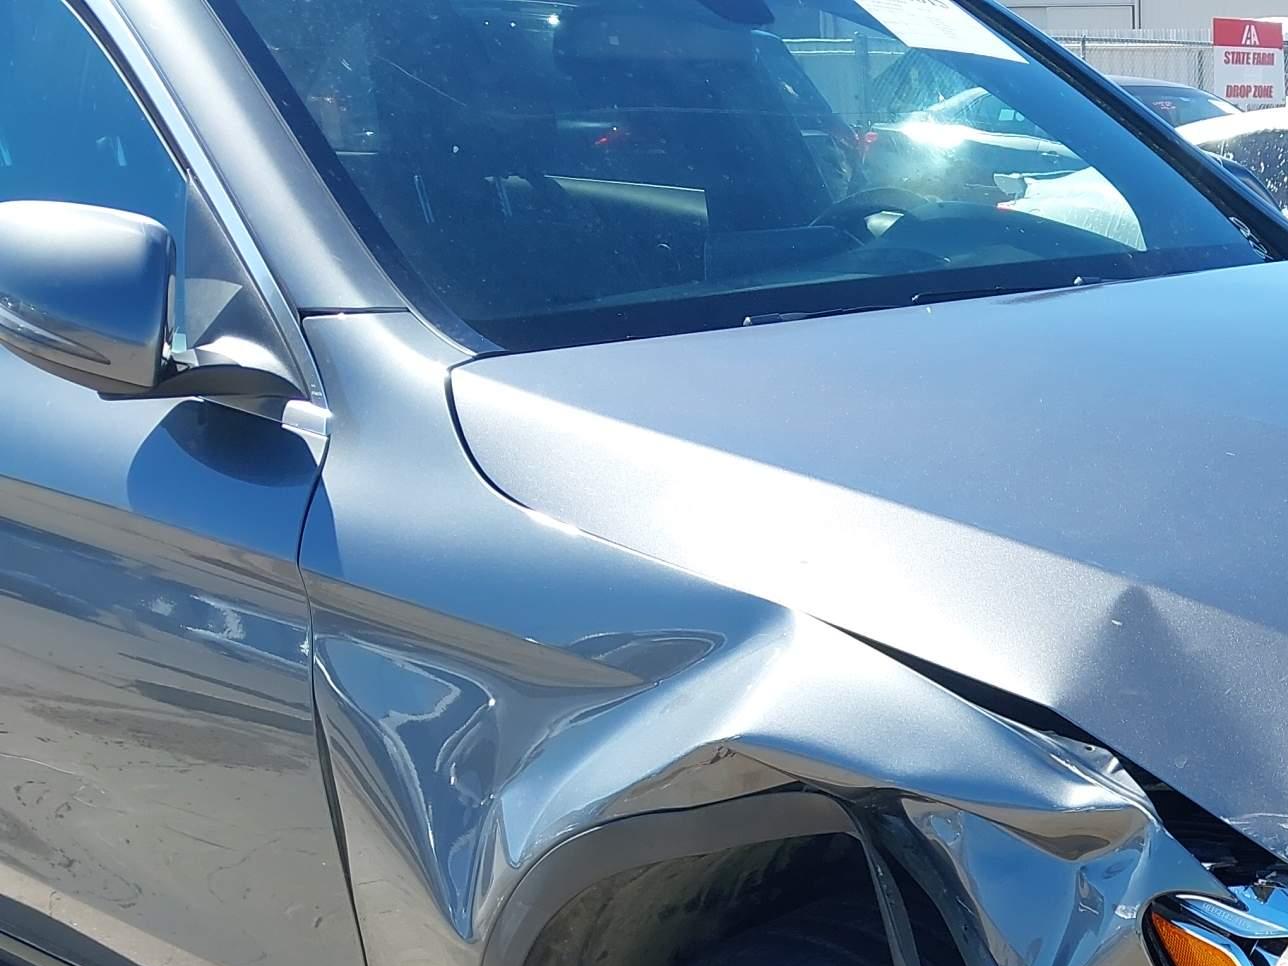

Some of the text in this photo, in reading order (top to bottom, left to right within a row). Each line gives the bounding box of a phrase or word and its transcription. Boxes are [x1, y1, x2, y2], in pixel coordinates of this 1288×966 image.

[1224, 51, 1275, 66] STATE FARM
[1226, 84, 1273, 98] DROP ZONE
